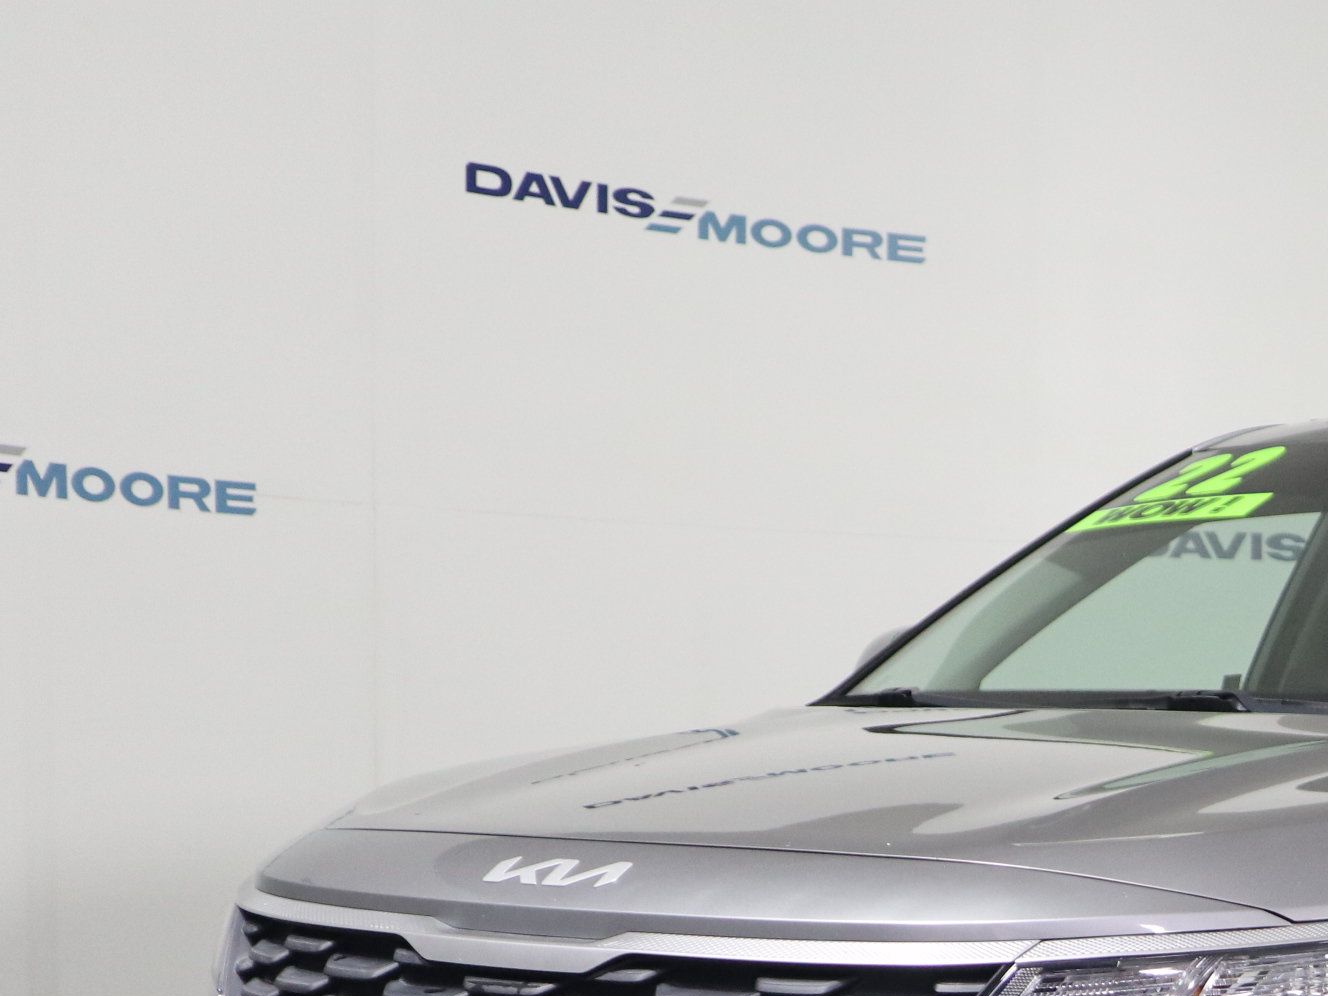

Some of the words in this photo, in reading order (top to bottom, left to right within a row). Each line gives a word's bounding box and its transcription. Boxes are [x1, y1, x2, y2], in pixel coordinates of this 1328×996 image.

[465, 161, 655, 219] DAVIS
[698, 210, 926, 264] MOORE
[15, 459, 257, 516] MOORE
[1133, 446, 1286, 502] 22
[1150, 531, 1306, 562] AVIS
